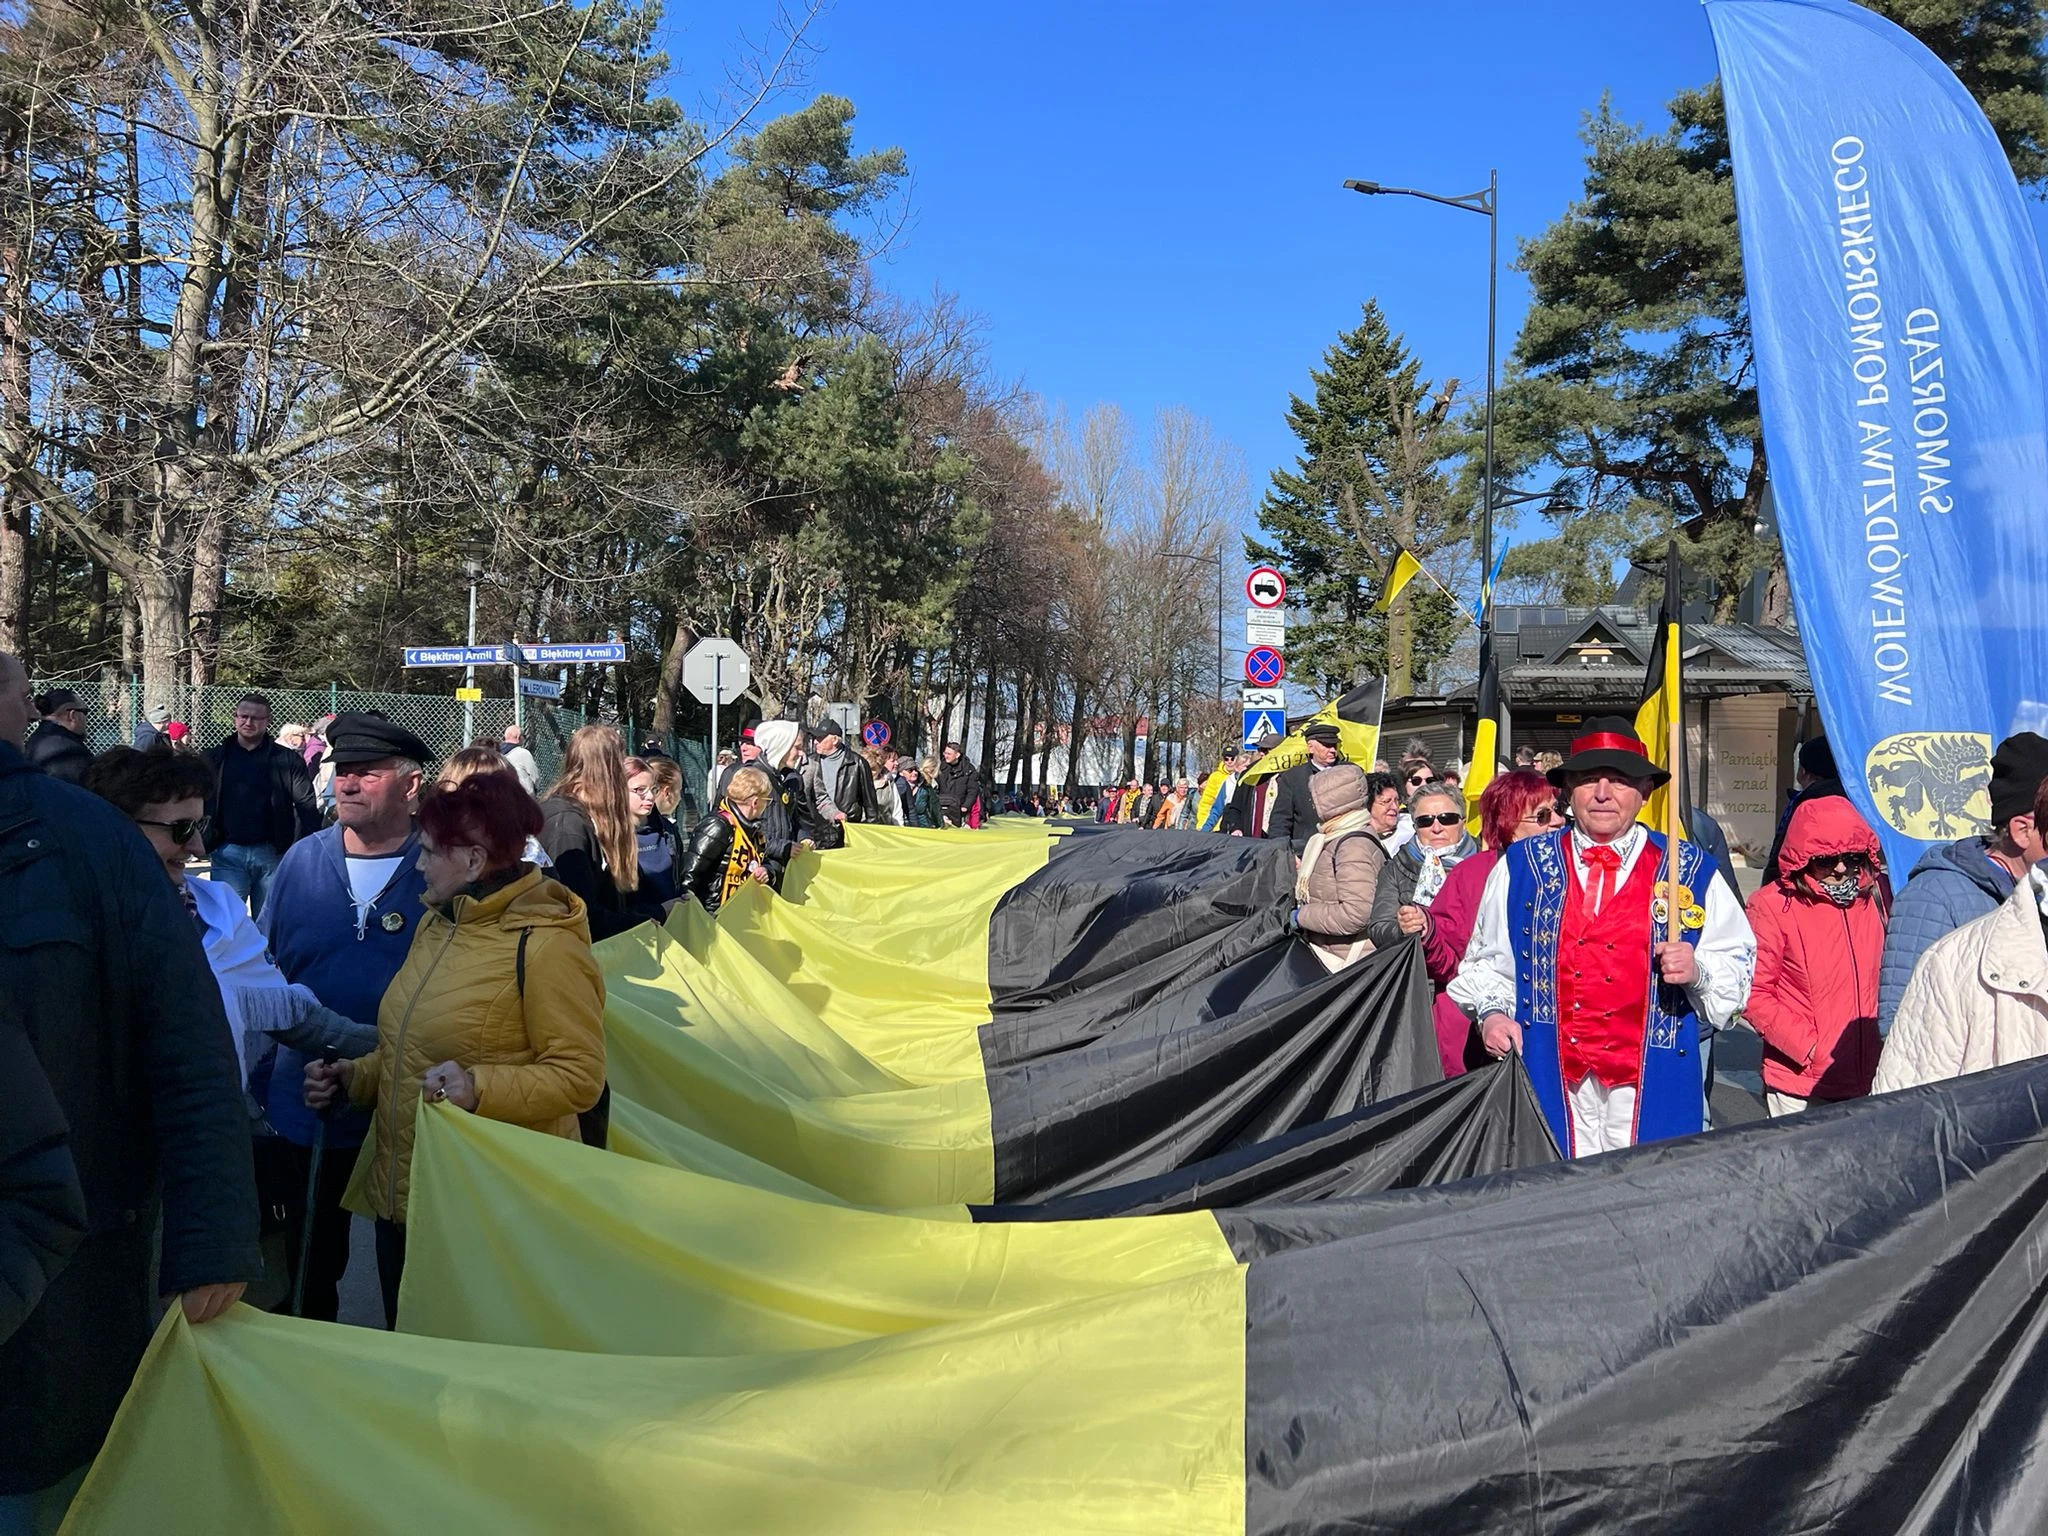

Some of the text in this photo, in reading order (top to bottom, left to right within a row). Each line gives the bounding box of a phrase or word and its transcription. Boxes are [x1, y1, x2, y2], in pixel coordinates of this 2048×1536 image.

[420, 650, 492, 663] Błękitnej Armii
[540, 647, 611, 660] Błękitnej Armii
[1732, 774, 1768, 790] znad
